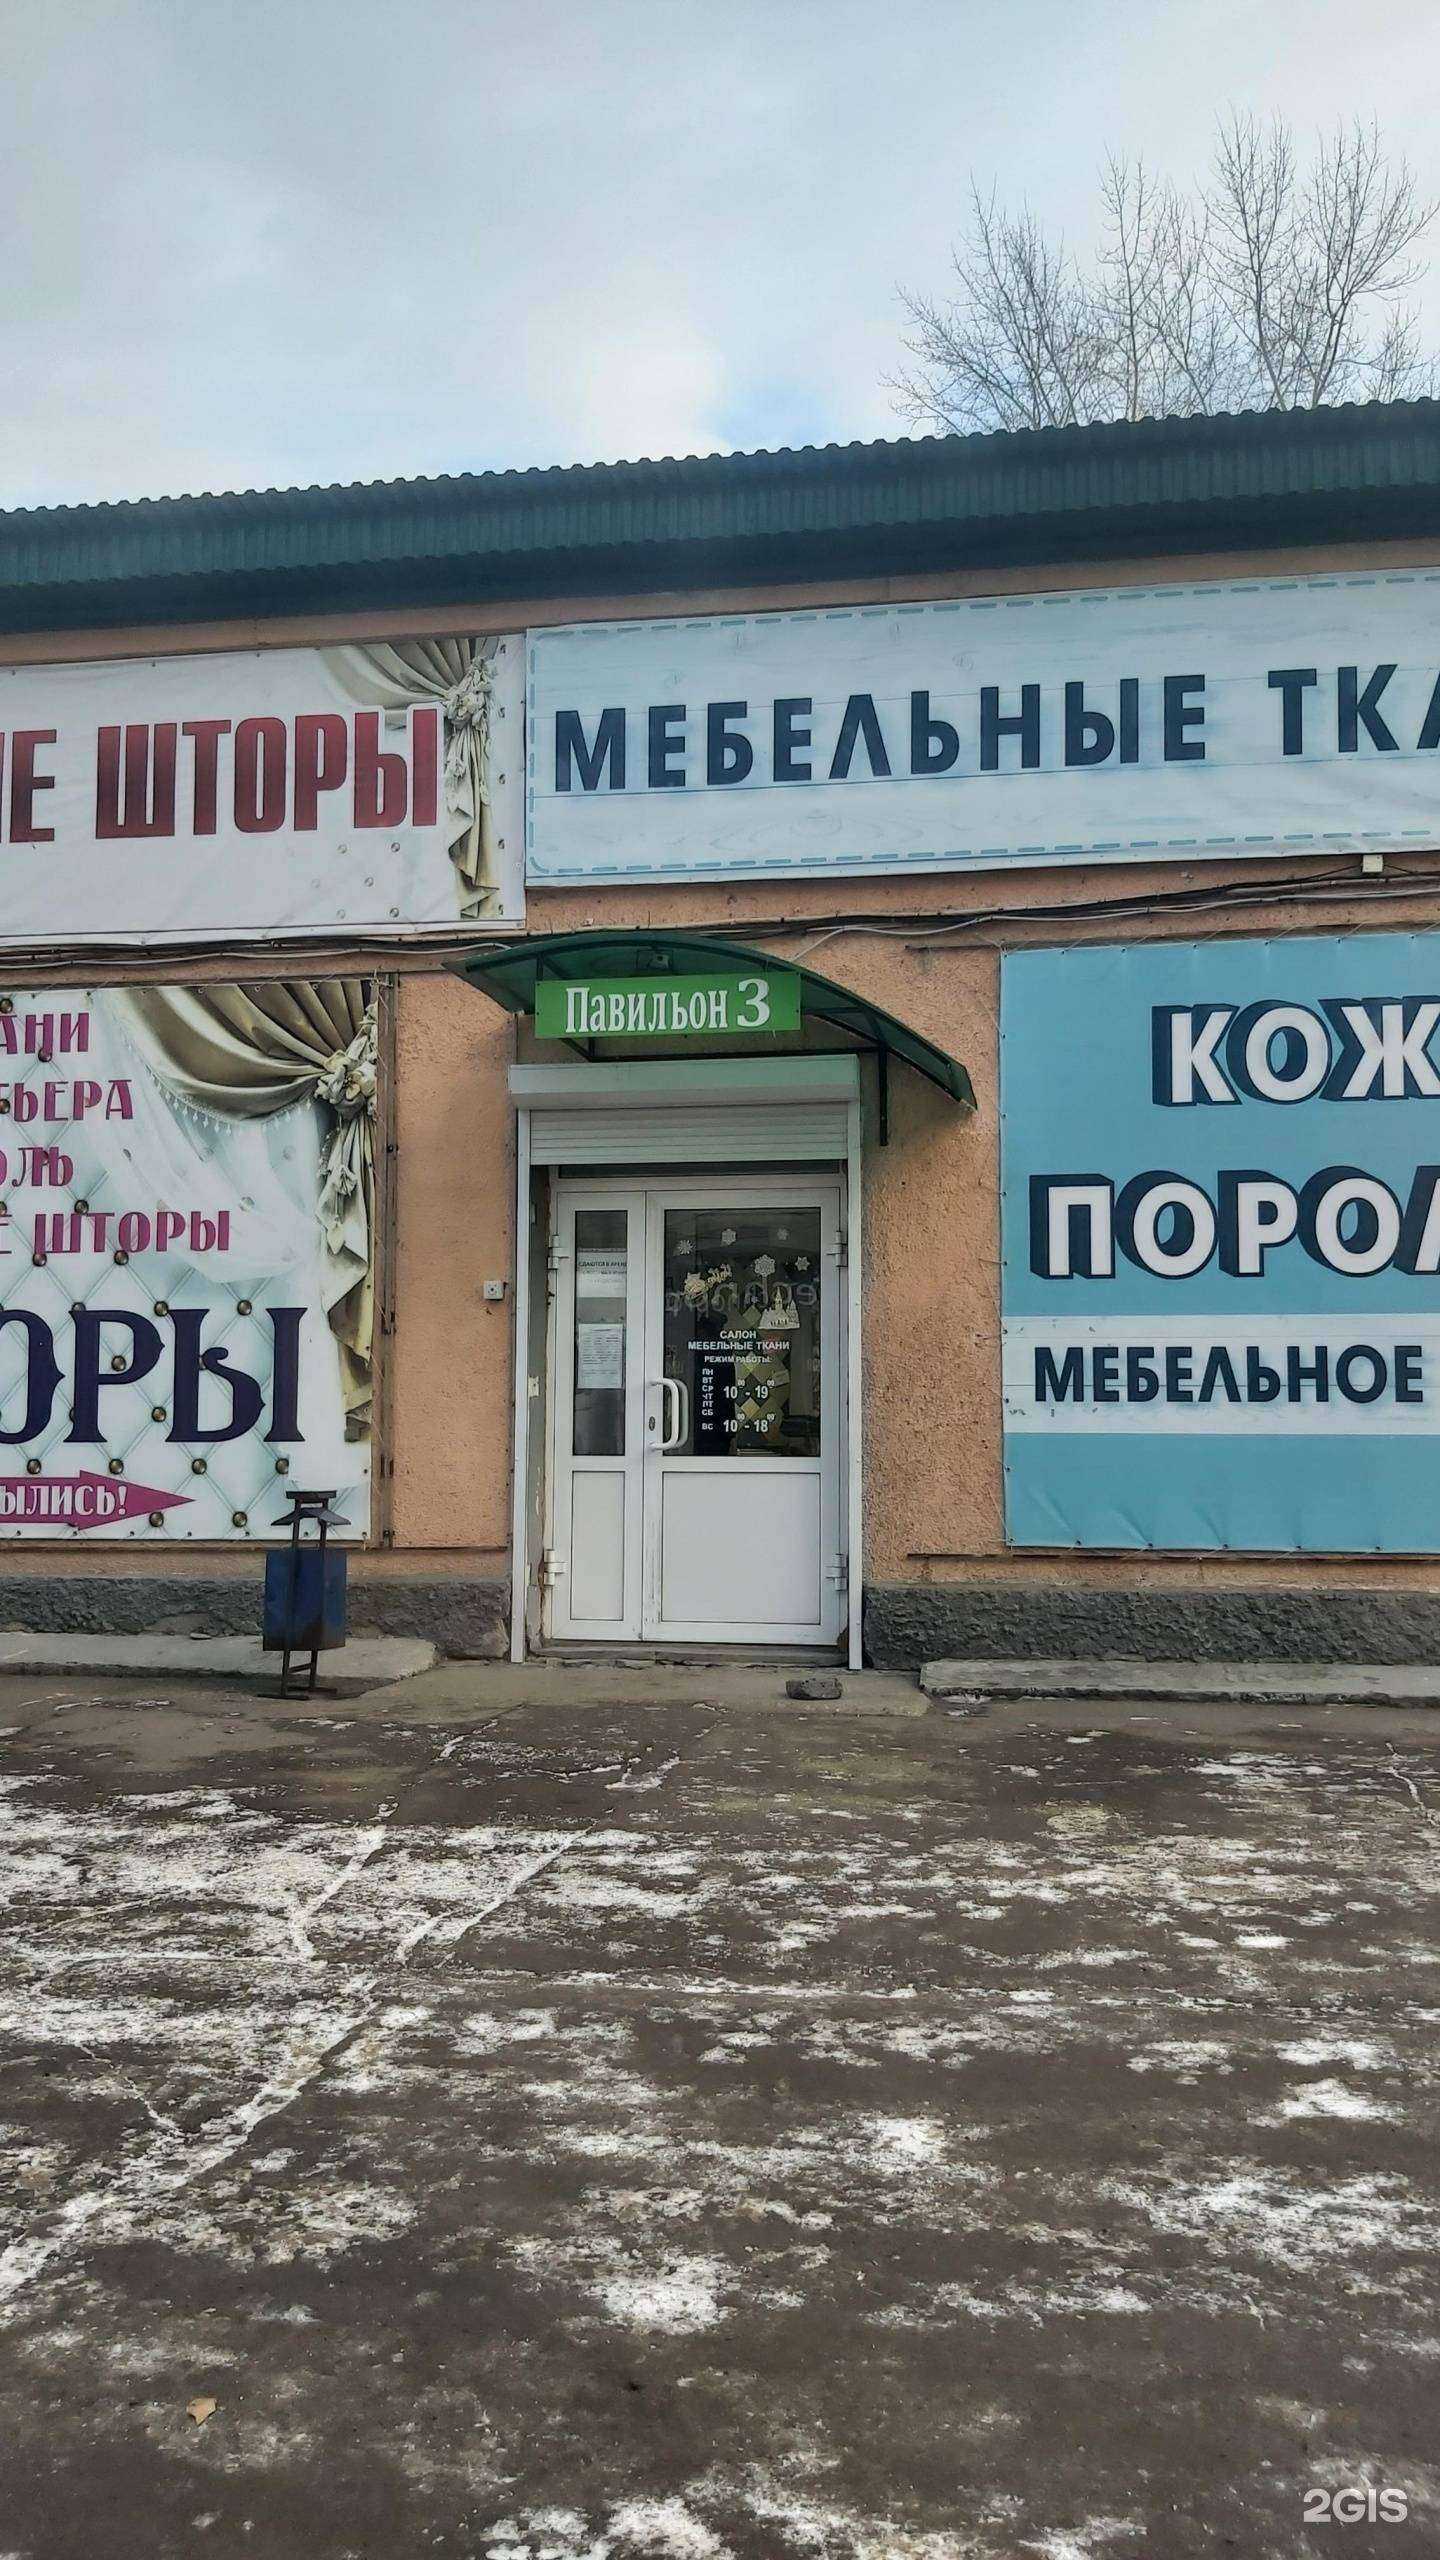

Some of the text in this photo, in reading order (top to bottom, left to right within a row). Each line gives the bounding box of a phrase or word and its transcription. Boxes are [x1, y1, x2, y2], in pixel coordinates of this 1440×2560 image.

[555, 674, 1206, 792] МЕБЕЛЬНЫЕ
[0, 708, 437, 843] Е ШТОРЫ
[565, 978, 770, 1033] Павильон 3
[1152, 995, 1440, 1107] КОЖ
[0, 1146, 73, 1187] ЛЬ
[34, 1210, 230, 1254] ШТОРЫ
[688, 1341, 790, 1350] МЕБЕЛЬНЫЕ ТКАНИ
[720, 1330, 756, 1339] САЛОН
[1034, 1344, 1424, 1403] МЕБЕЛЬНОЕ
[0, 1485, 127, 1515] ЫЛИСЬ!
